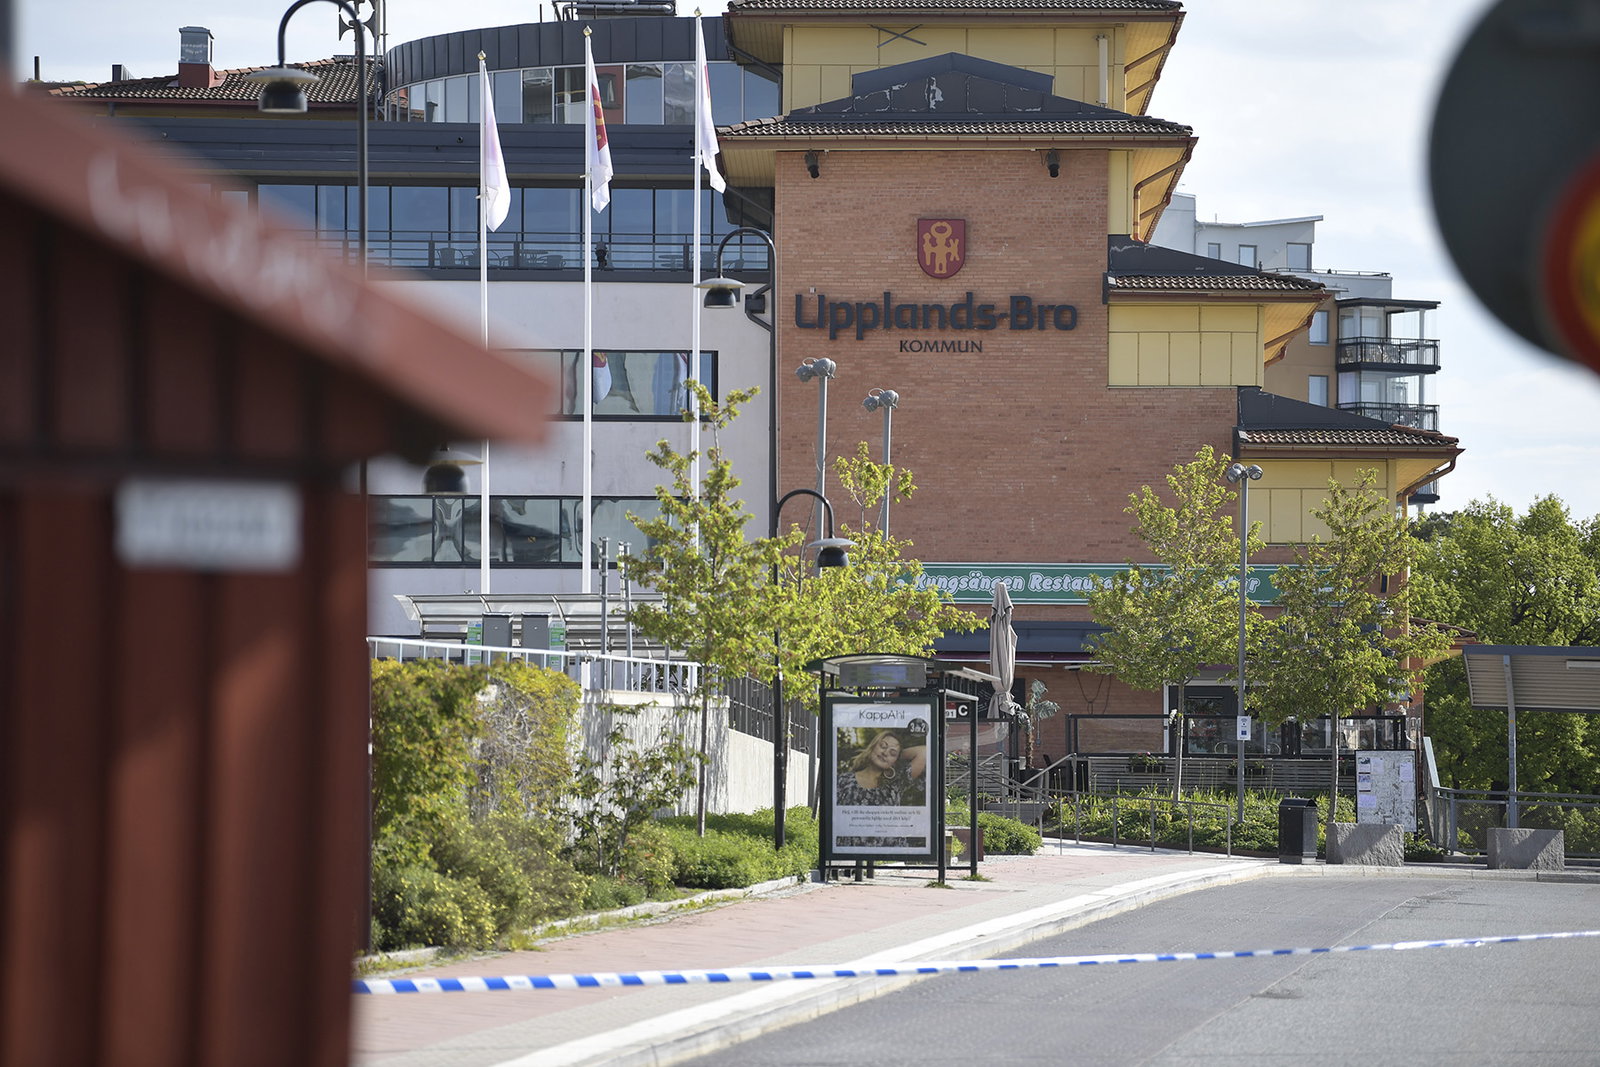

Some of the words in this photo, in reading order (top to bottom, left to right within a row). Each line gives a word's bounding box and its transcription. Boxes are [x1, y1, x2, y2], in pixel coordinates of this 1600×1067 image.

[795, 291, 1078, 340] Upplands-Bro
[900, 340, 983, 353] KOMMUN
[859, 709, 905, 722] KappAhl
[958, 705, 968, 716] C
